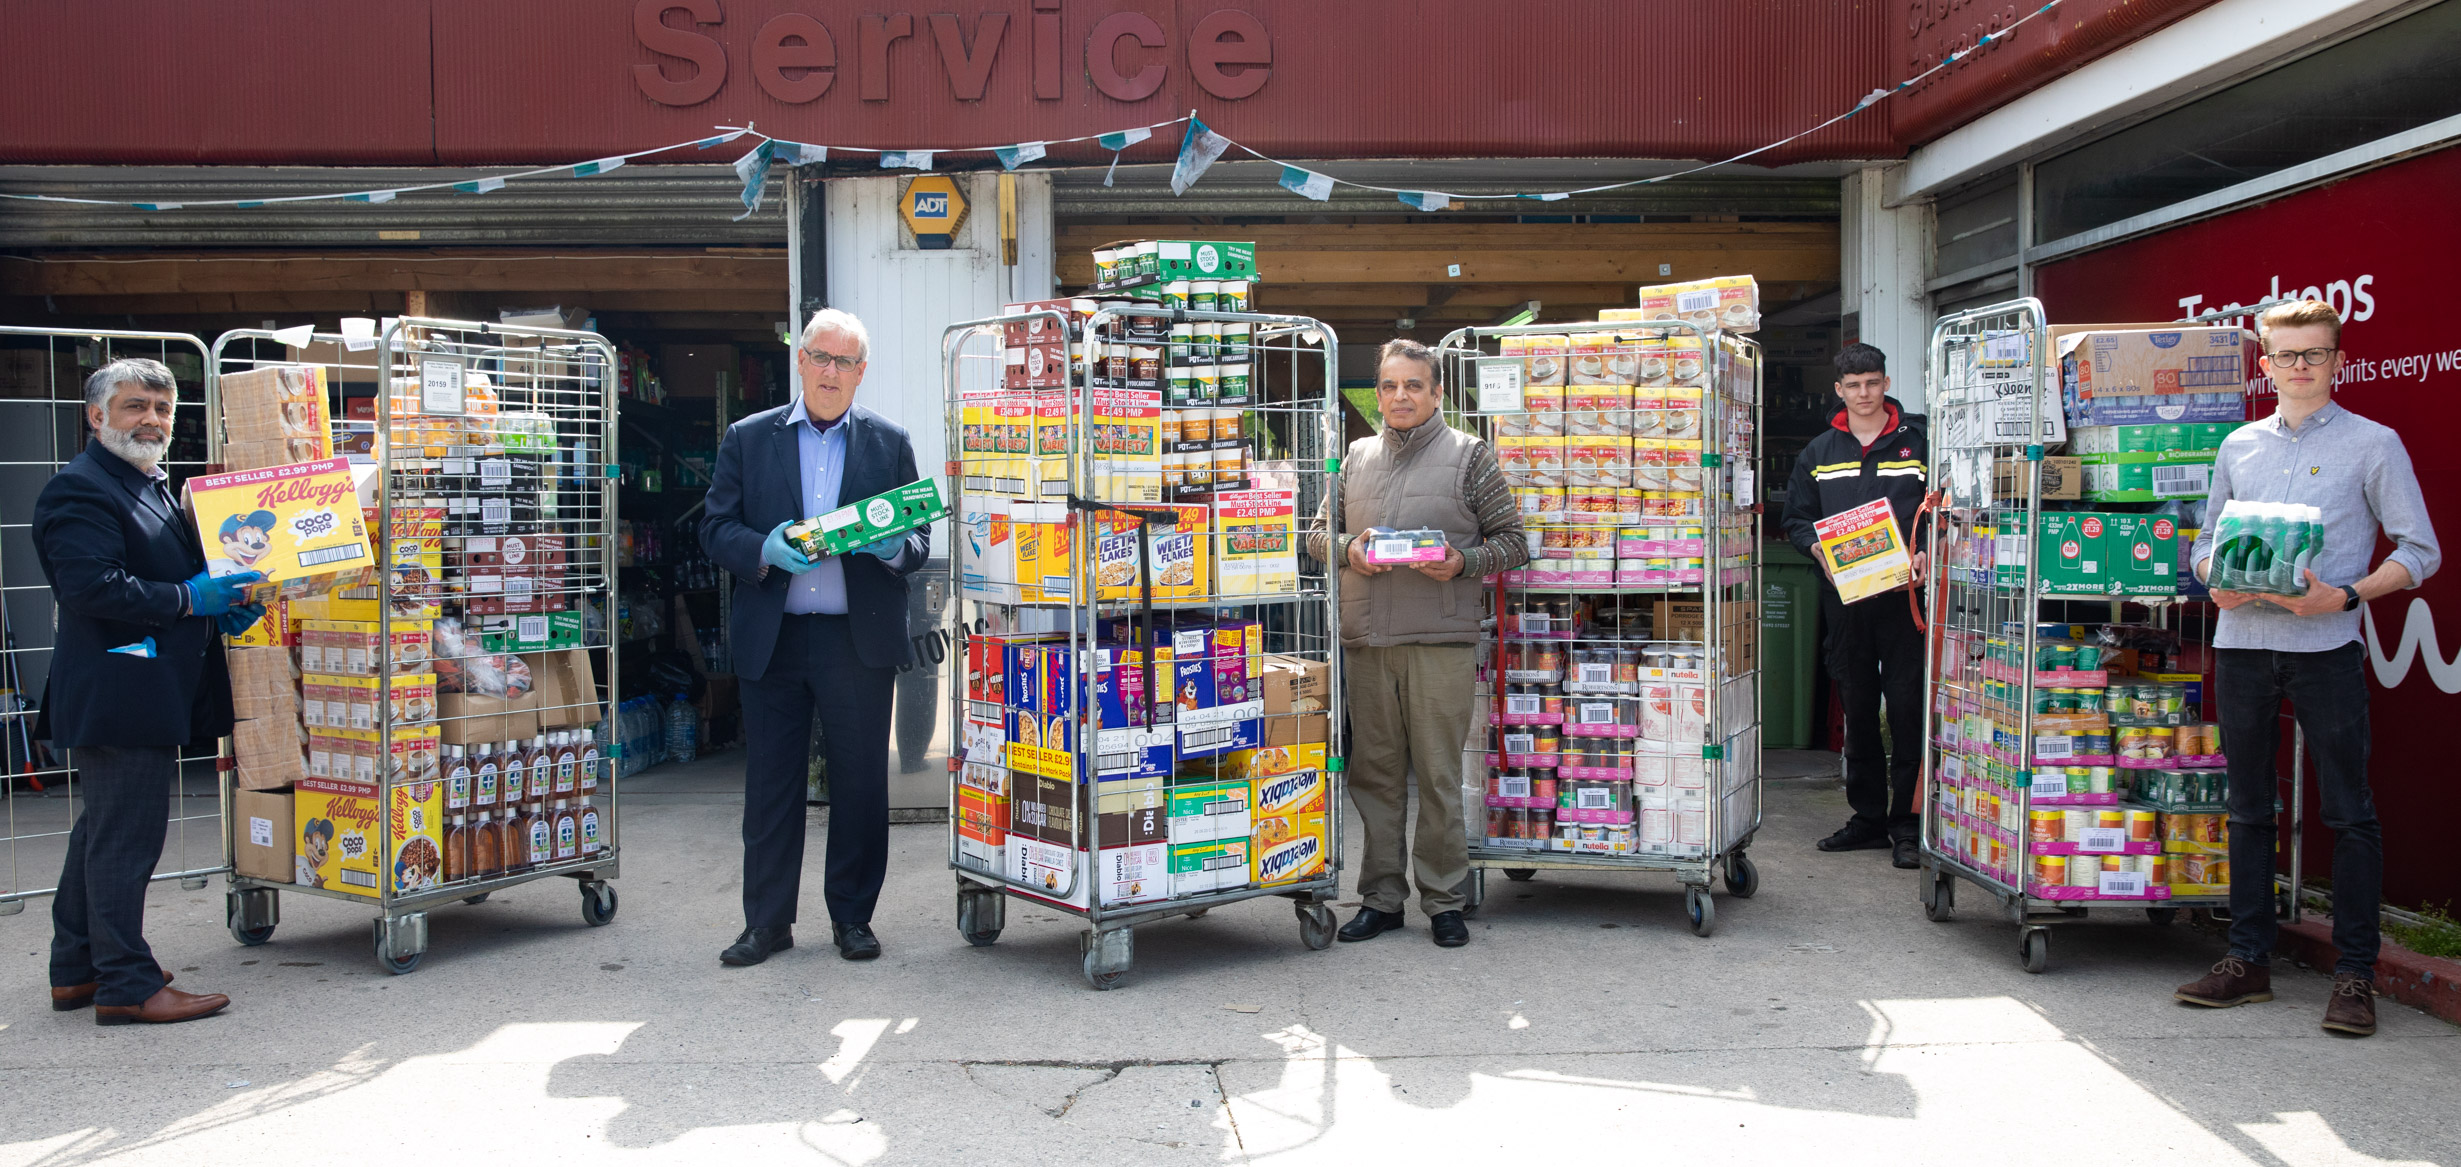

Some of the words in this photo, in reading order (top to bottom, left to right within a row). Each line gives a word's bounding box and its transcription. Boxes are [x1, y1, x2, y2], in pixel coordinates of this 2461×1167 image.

[633, 0, 1271, 105] Service
[1907, 5, 2019, 97] Entrance
[914, 198, 948, 218] ADT
[2153, 335, 2180, 345] Tetley
[2209, 336, 2228, 344] 3431
[2079, 366, 2089, 375] 80
[2331, 359, 2376, 393] pirits
[2381, 354, 2432, 382] every
[2156, 373, 2175, 384] 80
[1993, 383, 2032, 397] Kleen
[1012, 408, 1024, 416] PMP
[1045, 408, 1059, 416] £2.49
[2160, 408, 2182, 416] Tetley
[205, 476, 232, 487] BEST
[234, 471, 275, 483] SELLER
[311, 463, 334, 472] PMP
[256, 476, 356, 508] Kellogg's
[903, 492, 934, 501] SANDWICHES
[871, 503, 886, 513] MUST
[871, 508, 890, 519] STOCK
[1237, 508, 1256, 517] £2.49
[1260, 508, 1276, 516] PMP
[1858, 505, 1875, 514] Seller
[877, 514, 890, 523] LINE
[304, 521, 332, 537] pops
[1836, 526, 1856, 536] £2.49
[1858, 519, 1873, 529] PMP
[1231, 538, 1283, 551] VARIETY
[1840, 540, 1887, 562] VARIETY
[554, 621, 578, 629] SANDWICHES
[1671, 671, 1698, 679] nutella
[303, 781, 316, 789] BEST
[318, 782, 338, 791] SELLER
[1260, 769, 1318, 807] Weetabix
[326, 797, 380, 829] Kellogg's
[347, 846, 362, 855] pops
[1260, 837, 1318, 877] Weetabix
